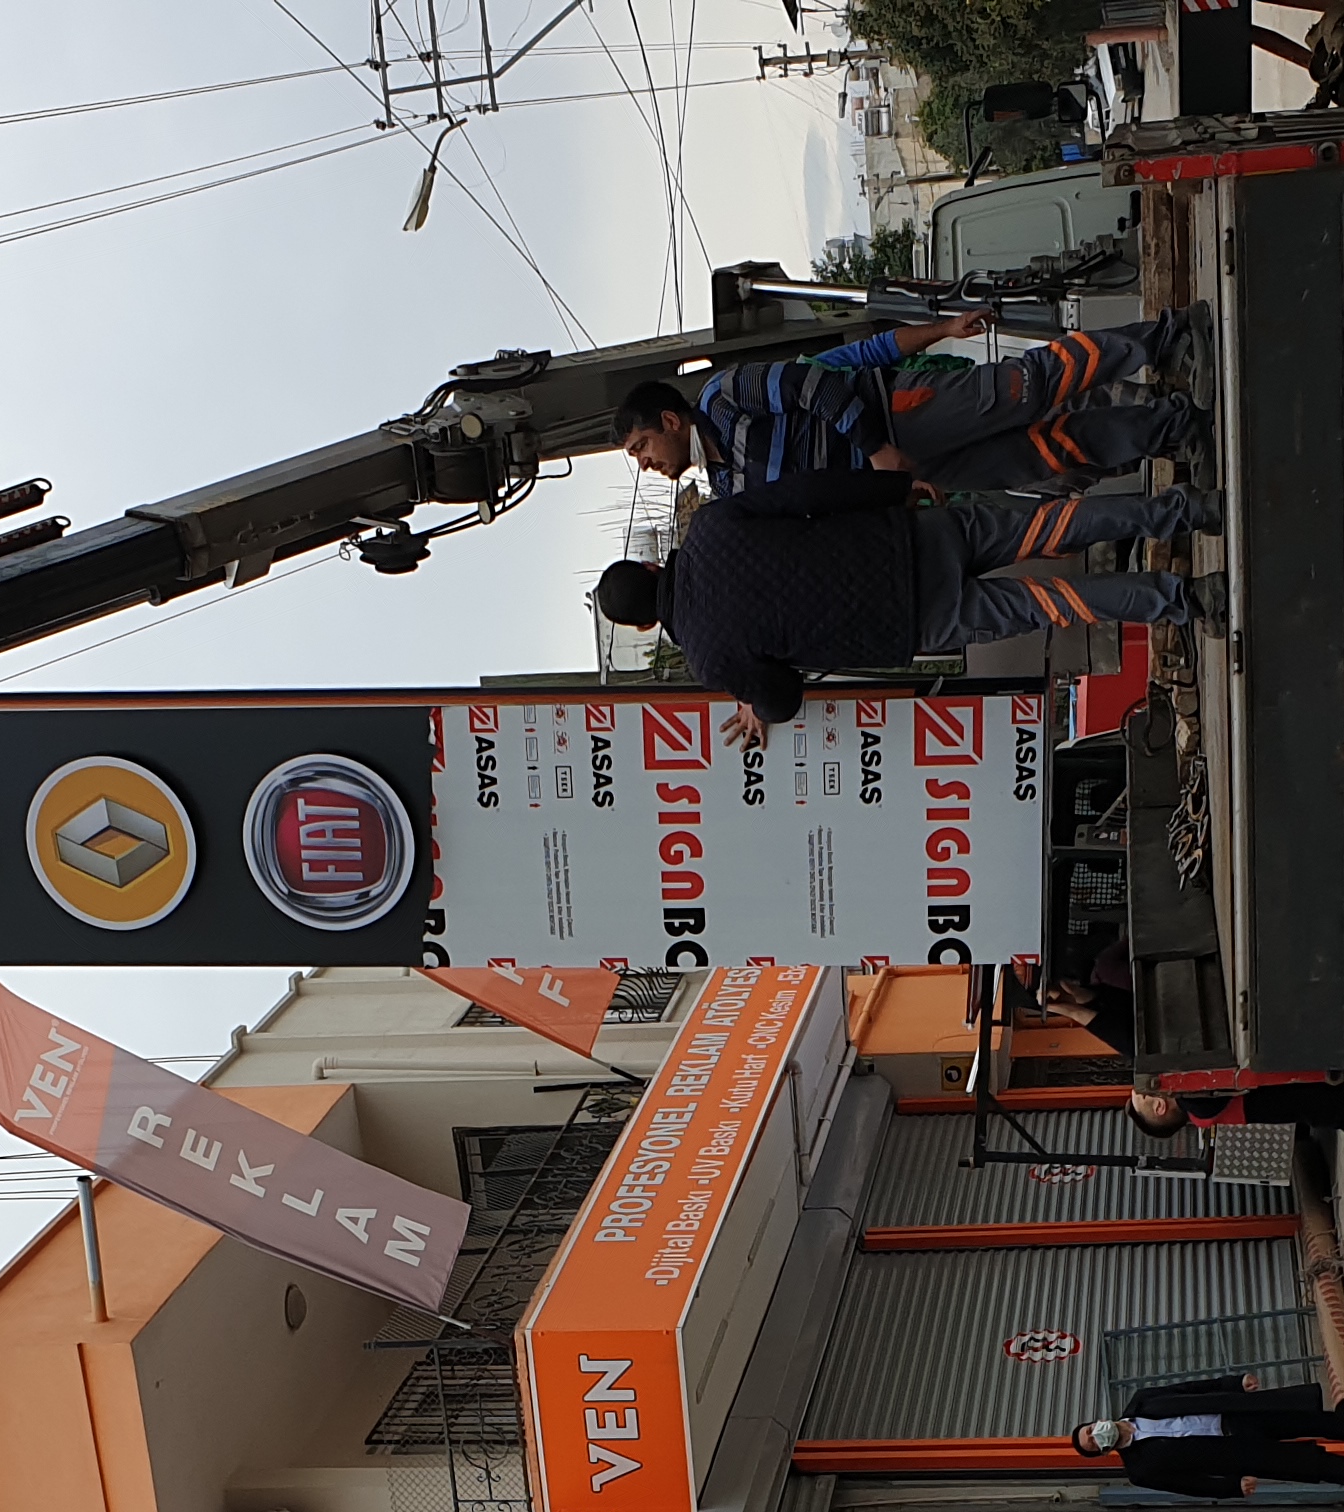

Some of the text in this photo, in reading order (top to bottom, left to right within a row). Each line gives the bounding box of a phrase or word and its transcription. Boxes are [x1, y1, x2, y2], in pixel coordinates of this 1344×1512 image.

[297, 797, 364, 882] FIAT
[747, 1020, 784, 1046] CNC
[13, 1026, 82, 1122] VEN
[732, 1054, 769, 1079] Harf
[719, 1080, 759, 1108] Kutu
[593, 1101, 698, 1243] PROFESYONEL
[665, 1031, 731, 1097] REKLAM
[698, 1120, 742, 1156] Baskı
[126, 1104, 433, 1267] REKLAM
[687, 1158, 725, 1180] UV
[665, 1190, 714, 1231] Baskı
[644, 1234, 695, 1280] Dijital
[578, 1353, 643, 1493] VEN
